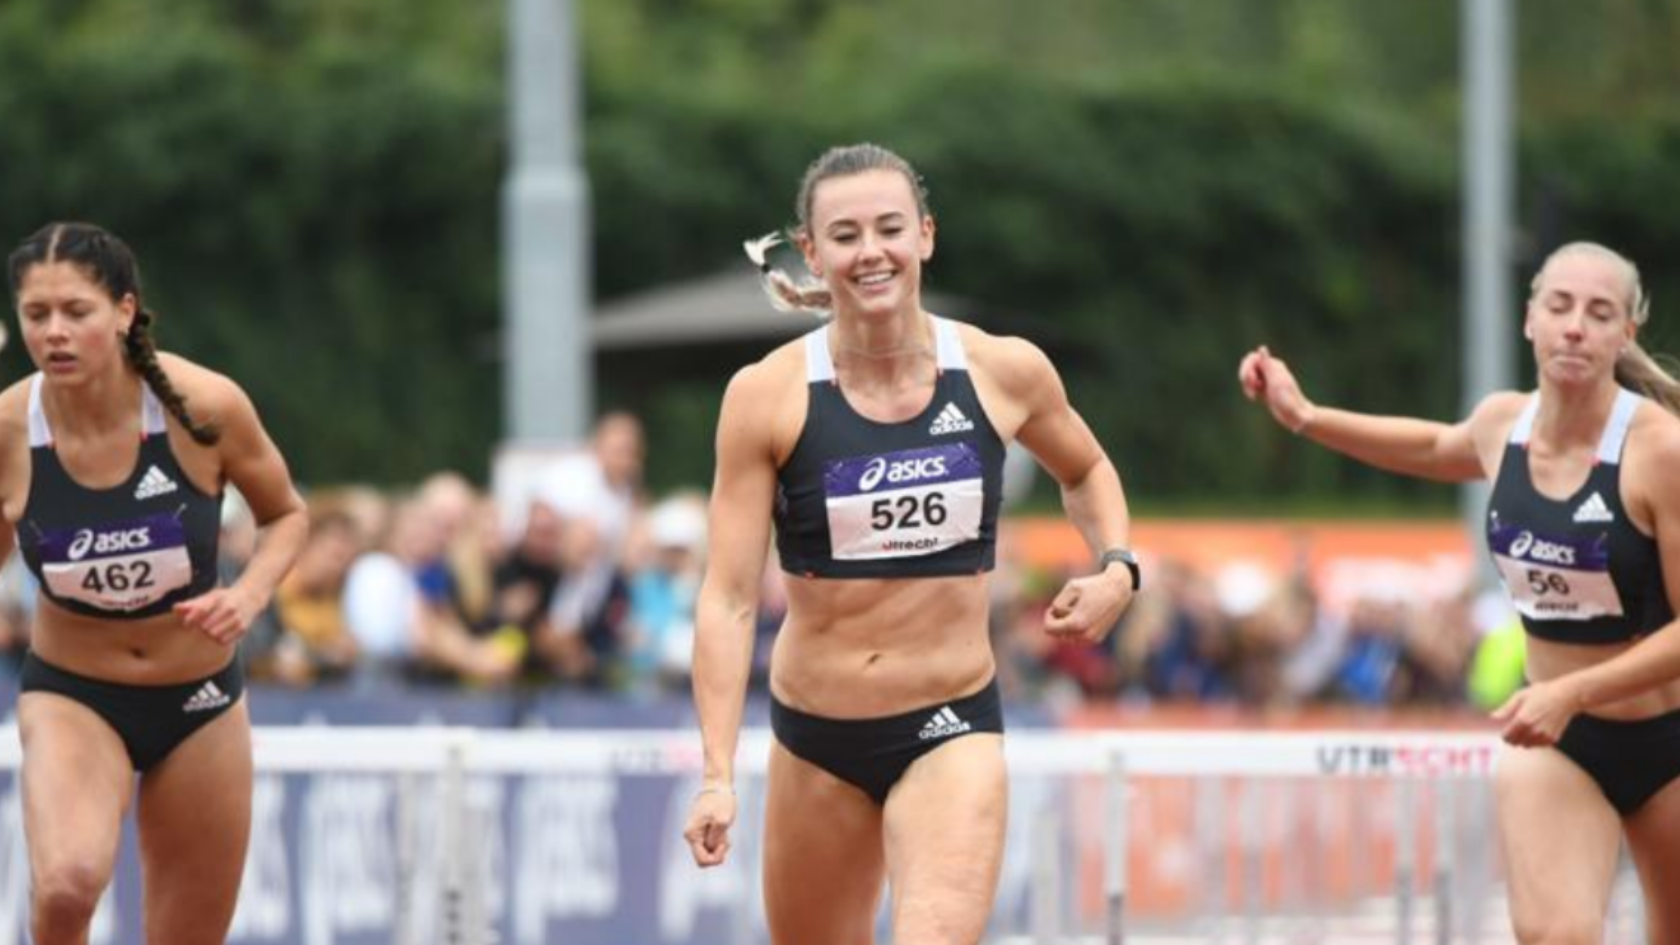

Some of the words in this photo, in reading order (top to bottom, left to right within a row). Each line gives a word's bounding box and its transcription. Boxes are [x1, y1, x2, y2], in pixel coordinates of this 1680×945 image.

[929, 419, 974, 434] adidas
[886, 456, 946, 482] asics
[871, 491, 947, 531] 526
[94, 527, 151, 553] asics
[81, 560, 154, 594] 462
[1527, 569, 1570, 595] 56
[919, 720, 971, 739] adidas
